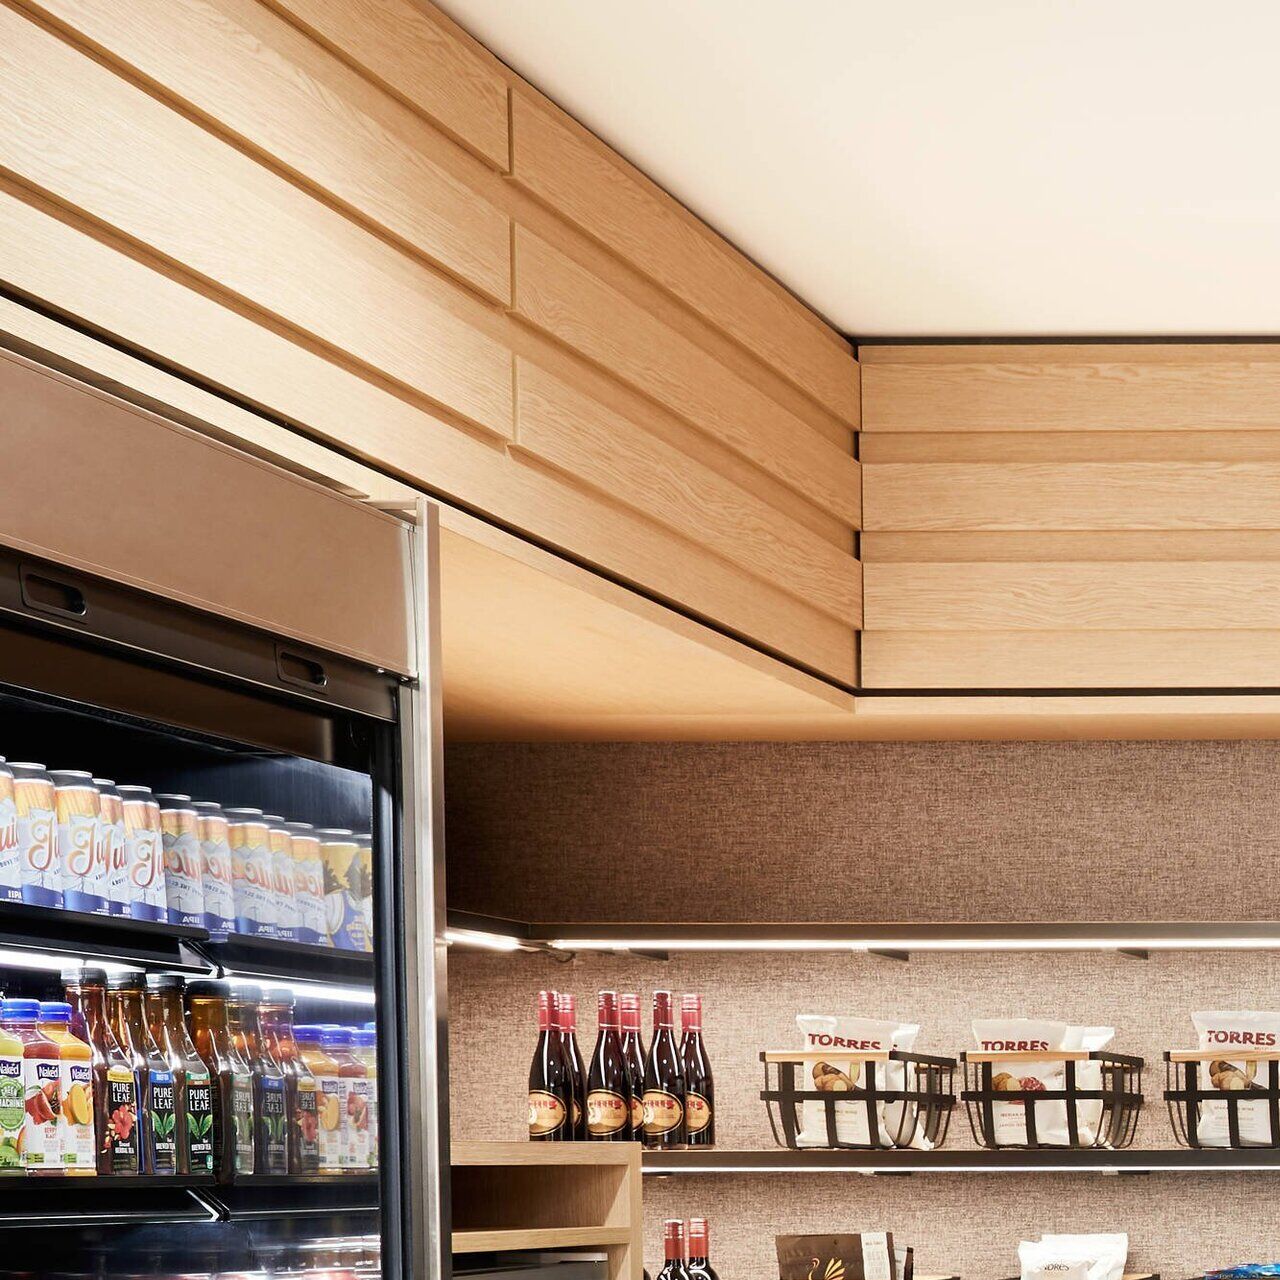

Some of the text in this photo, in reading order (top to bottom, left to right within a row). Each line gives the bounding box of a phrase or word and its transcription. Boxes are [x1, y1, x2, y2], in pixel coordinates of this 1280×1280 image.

[808, 1033, 881, 1050] TORRES
[981, 1041, 1049, 1051] TORRES
[1207, 1030, 1276, 1046] TORRES
